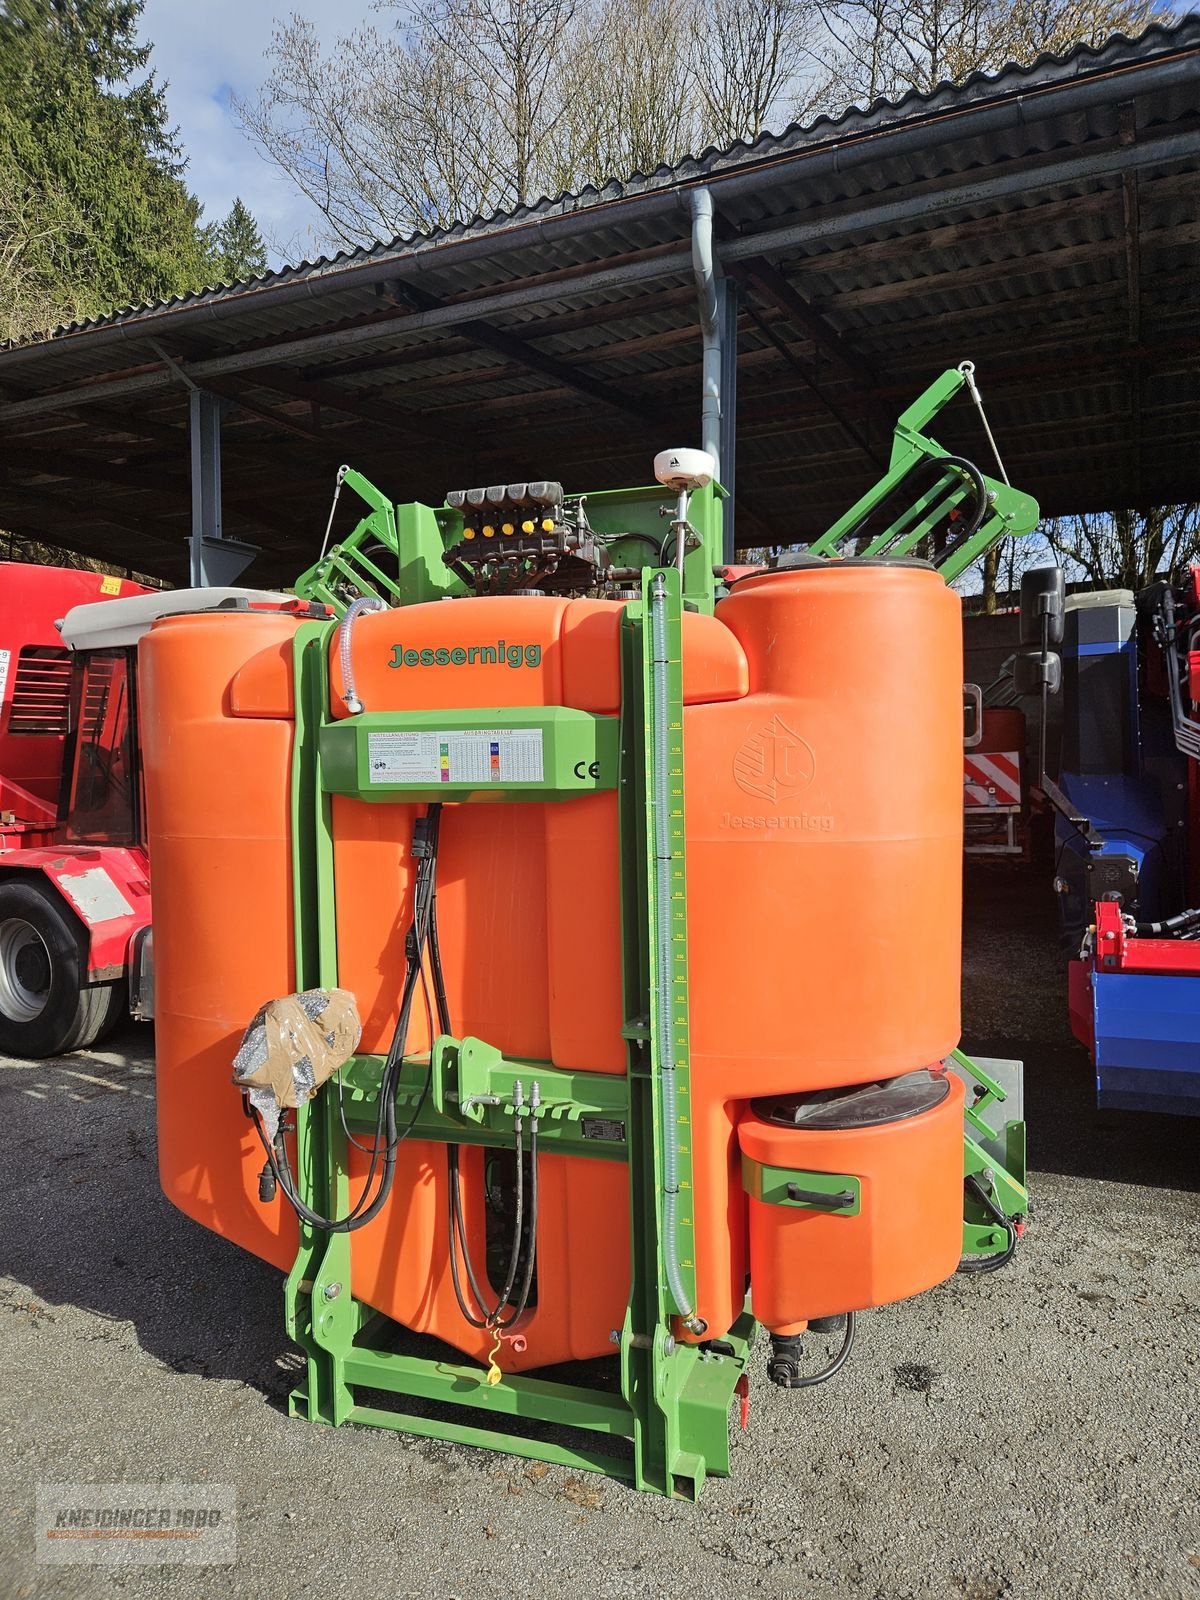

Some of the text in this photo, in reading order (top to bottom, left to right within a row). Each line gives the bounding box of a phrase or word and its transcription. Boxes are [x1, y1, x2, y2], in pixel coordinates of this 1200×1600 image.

[388, 640, 542, 669] Jessernigg
[574, 761, 600, 780] CE
[719, 812, 835, 832] Jessernigg
